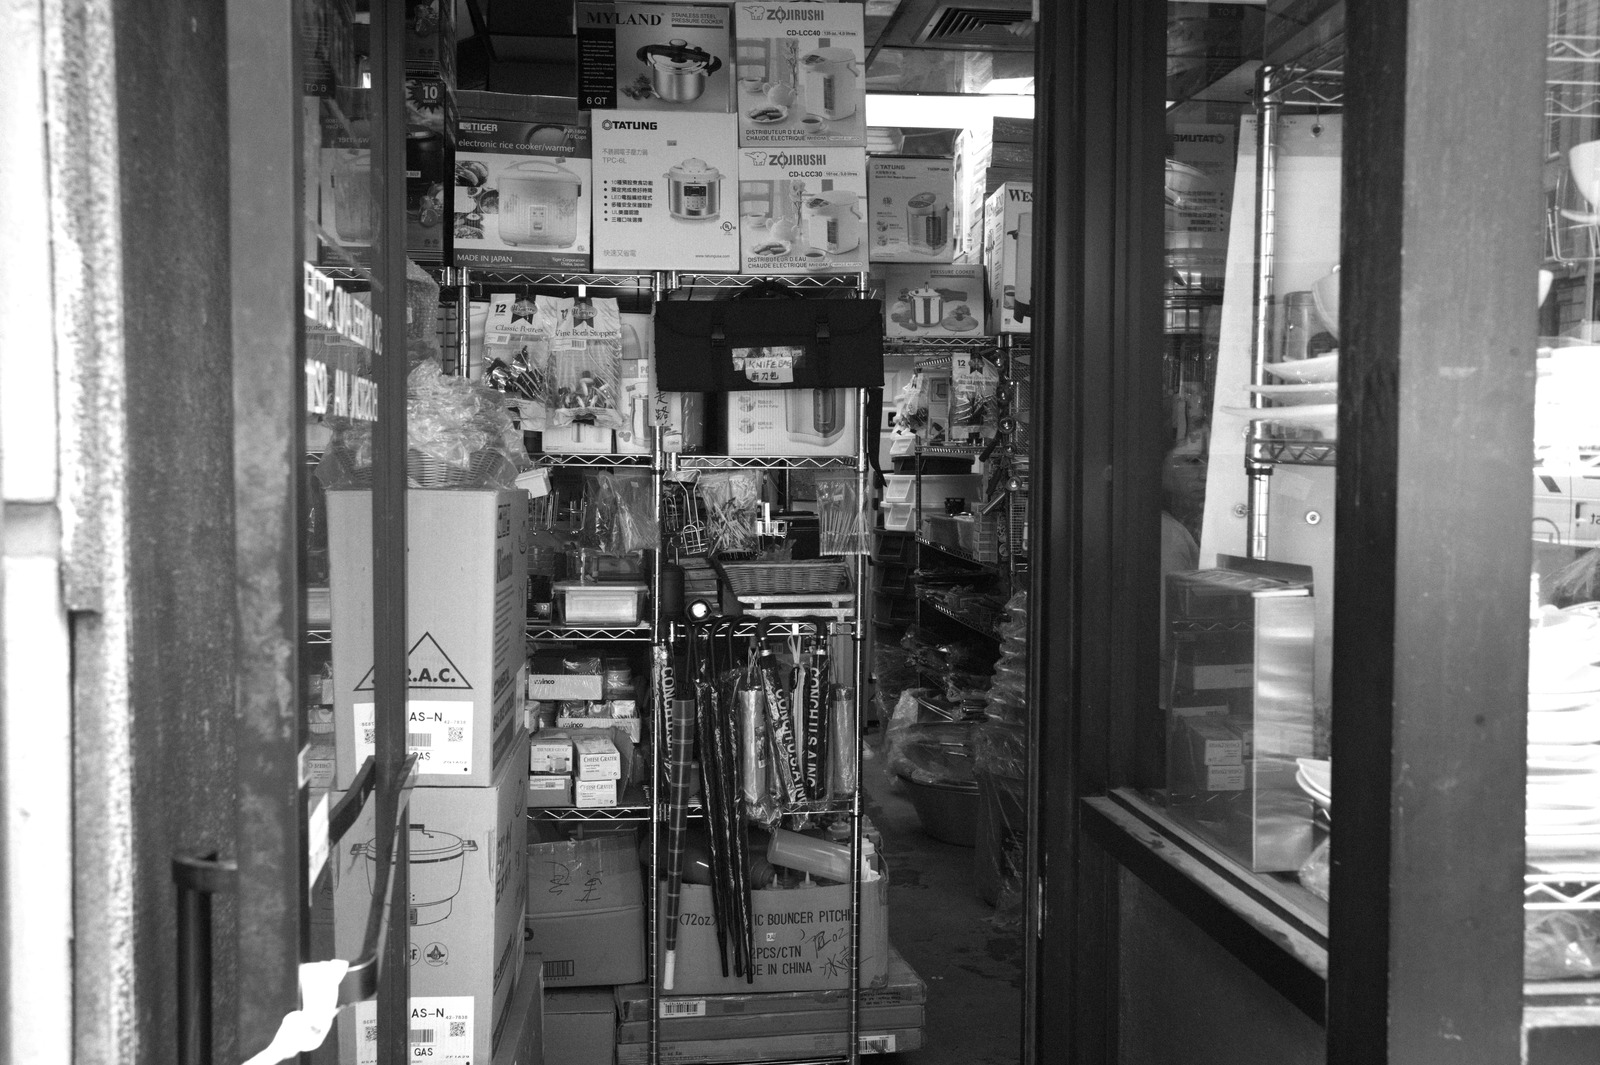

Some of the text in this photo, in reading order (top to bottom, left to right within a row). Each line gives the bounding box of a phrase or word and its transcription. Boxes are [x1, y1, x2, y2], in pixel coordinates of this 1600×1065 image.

[587, 11, 662, 26] MYLAND
[766, 6, 824, 24] ZOJIRUSHI
[423, 86, 438, 99] 10
[586, 97, 607, 105] 6 QT
[472, 123, 498, 132] TIGER
[612, 121, 658, 130] TATUNG
[458, 138, 575, 153] electronic rice cooker/warmer
[768, 151, 826, 169] ZOJIRUSHI
[457, 254, 479, 262] MADE
[490, 255, 513, 263] JAPAN
[495, 304, 506, 313] 12
[495, 324, 518, 332] Classic
[589, 328, 618, 339] Stoppers
[748, 360, 777, 369] KNIFE
[957, 359, 966, 367] 12
[679, 913, 716, 926] (72oz)
[767, 912, 814, 926] BOUNCER
[767, 963, 778, 975] IN
[782, 962, 813, 975] CHINA
[414, 1047, 434, 1057] GAS
